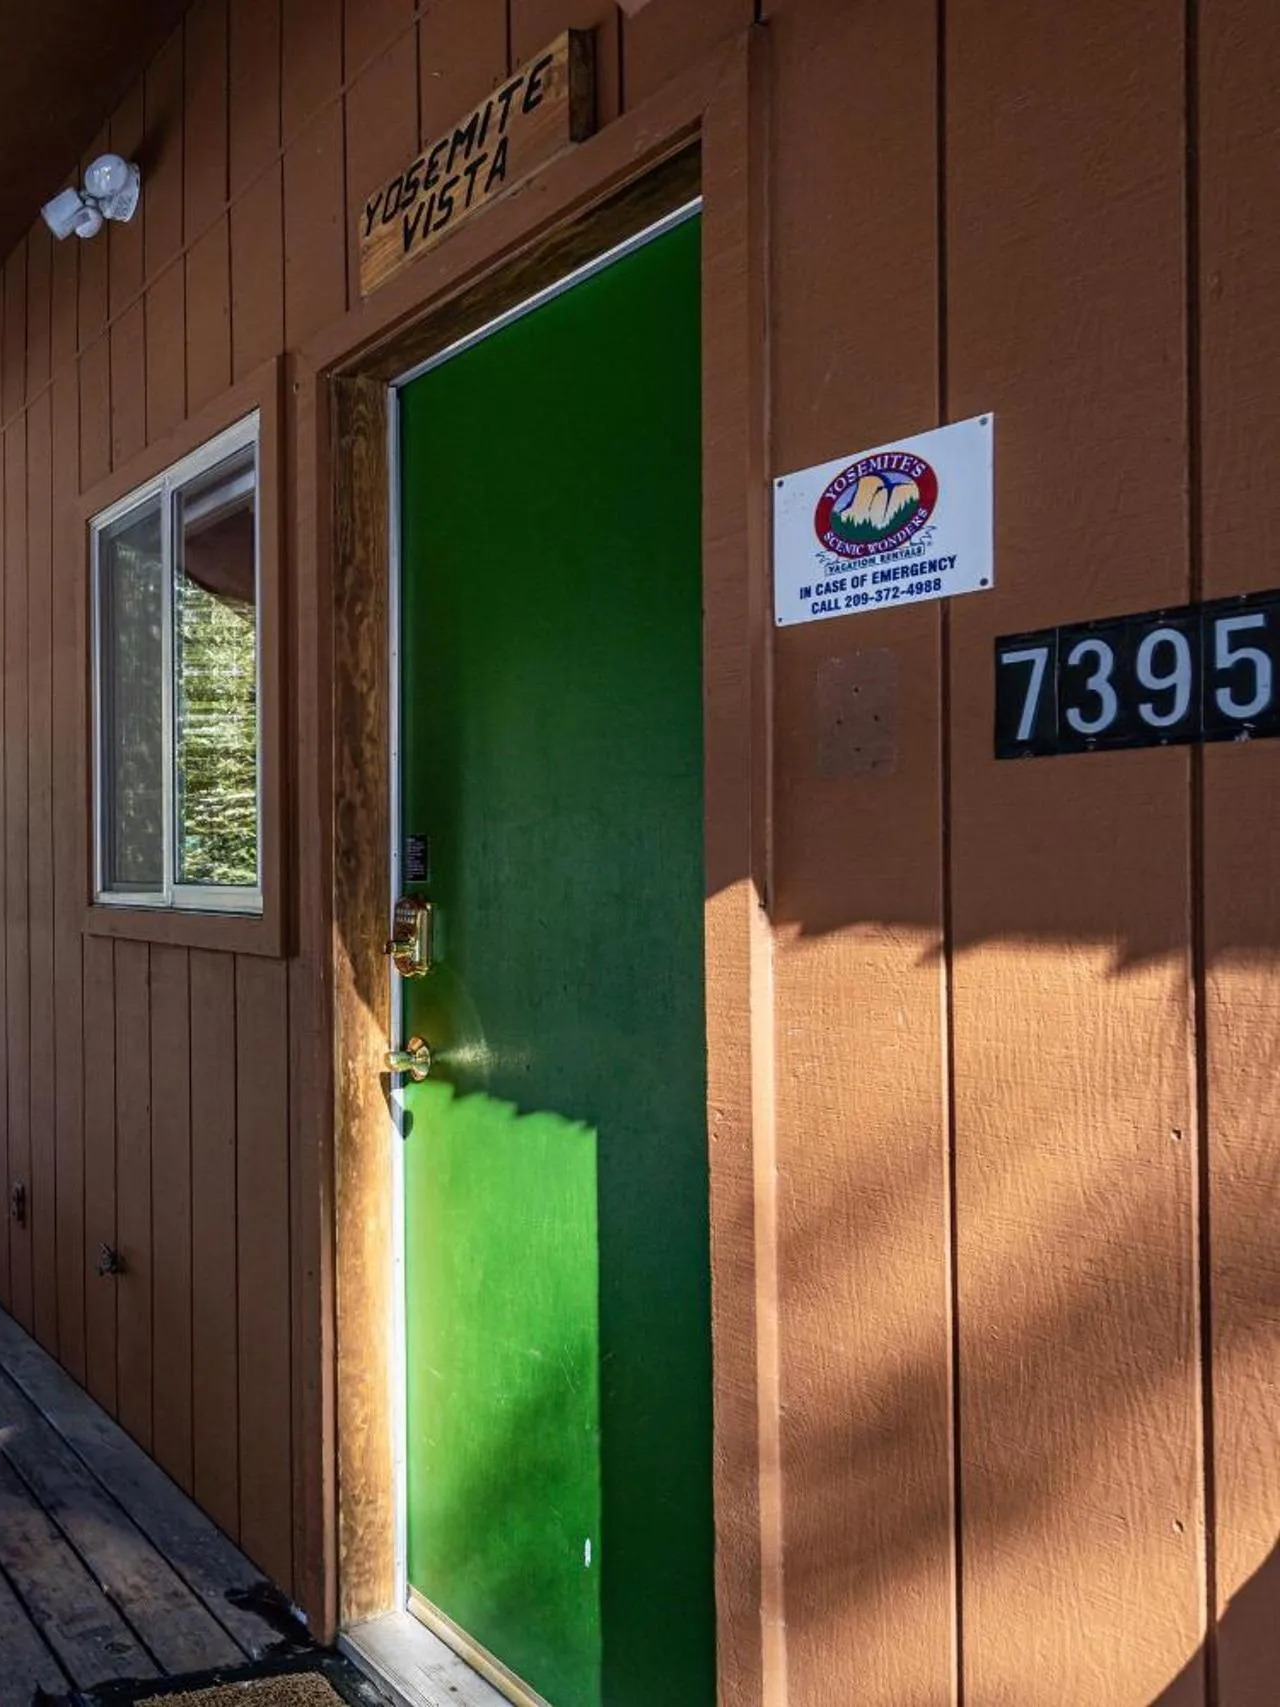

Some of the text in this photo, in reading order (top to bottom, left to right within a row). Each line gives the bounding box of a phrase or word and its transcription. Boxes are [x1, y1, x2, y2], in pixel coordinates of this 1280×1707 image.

[363, 53, 554, 237] YOSEMITE
[403, 136, 508, 253] VISTA
[825, 454, 926, 501] YOSEMITE'S
[823, 508, 928, 556] SCENIC WONDERS
[799, 555, 957, 600] IN CASE OF EMERGENCY
[828, 546, 923, 574] VACATION RENTALS
[811, 578, 942, 615] CALL 209-372-4988
[1001, 613, 1272, 741] 7395
